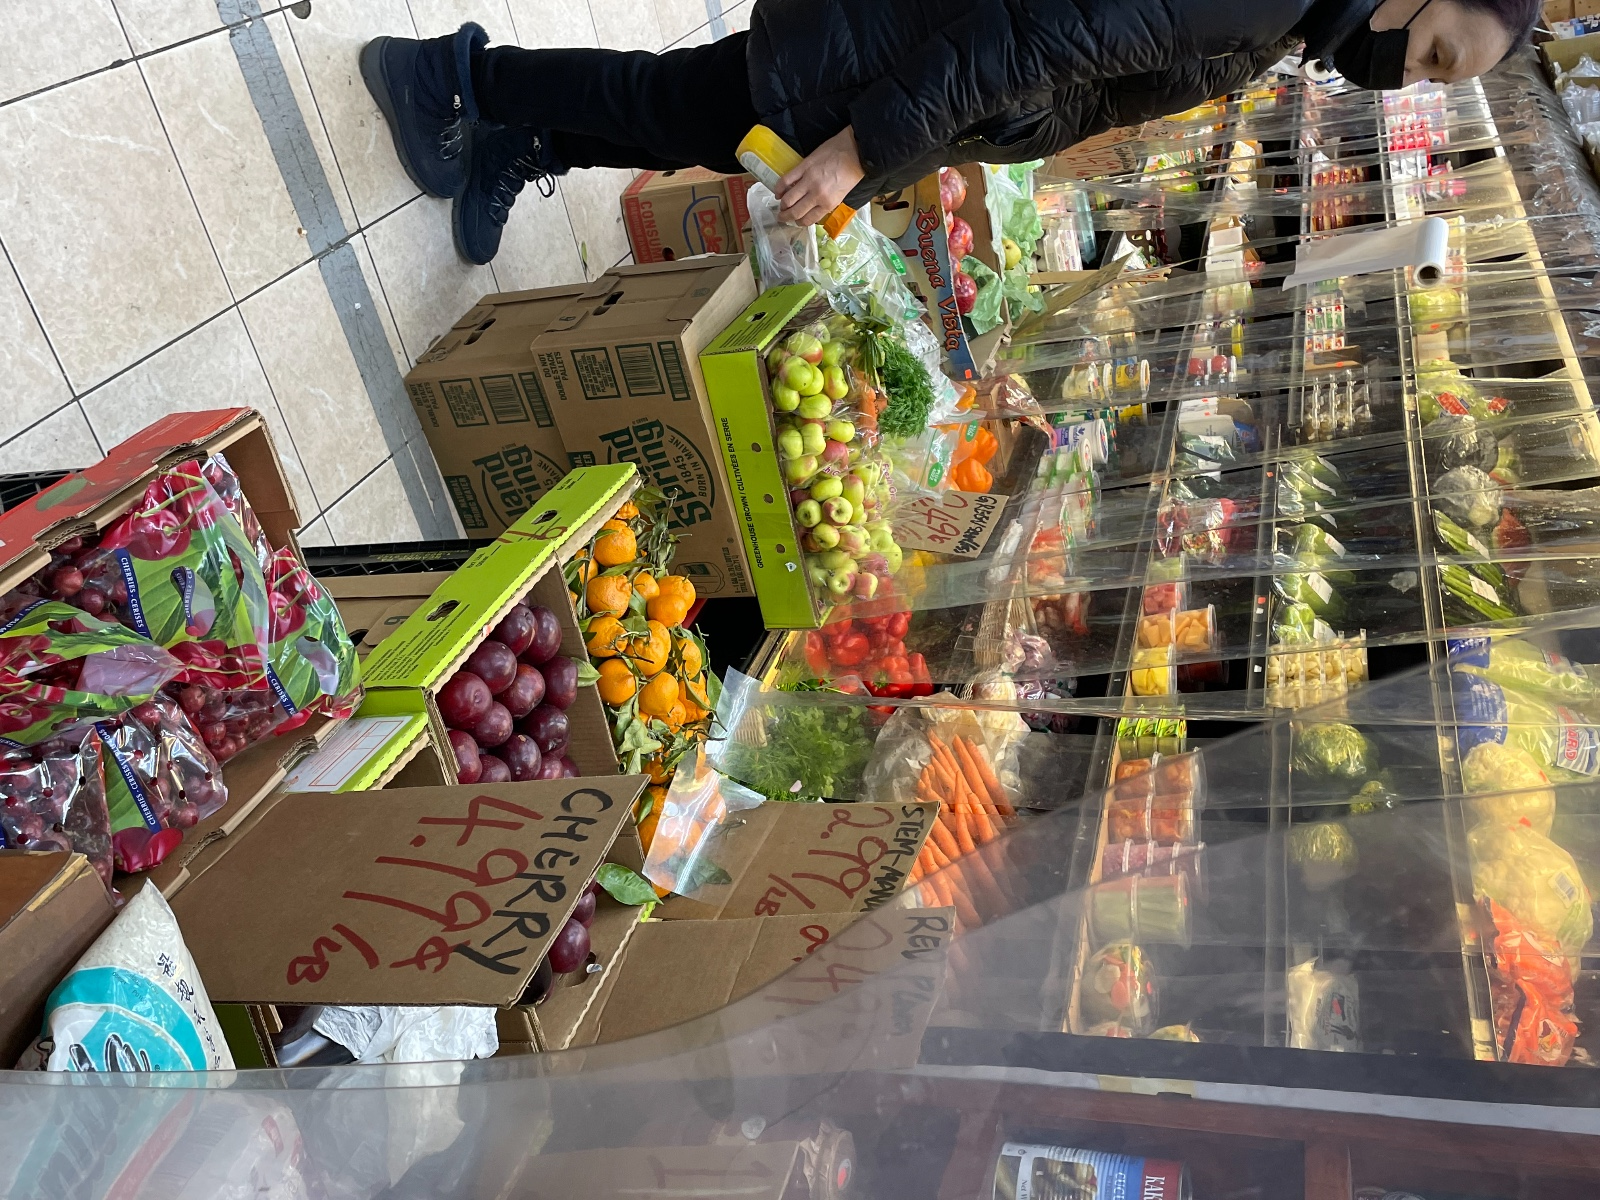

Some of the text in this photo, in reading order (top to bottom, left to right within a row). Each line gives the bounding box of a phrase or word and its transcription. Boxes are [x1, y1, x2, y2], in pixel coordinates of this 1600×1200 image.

[640, 201, 664, 262] CONSUM
[698, 208, 723, 254] Dole
[916, 205, 963, 351] Buena Vista
[538, 354, 552, 378] DO NOT
[546, 352, 567, 400] DOUBLE STACK
[553, 352, 568, 380] PALLETS
[409, 384, 423, 406] DO NOT
[416, 382, 440, 428] DOUBLE STACK
[424, 382, 439, 409] PALLETS
[720, 417, 732, 442] SERRE
[727, 442, 736, 453] EN
[472, 452, 529, 518] land
[631, 419, 712, 528] Spring
[668, 435, 706, 498] BORN IN MAINE
[673, 455, 694, 484] 1845
[740, 496, 753, 522] GROWN
[747, 523, 764, 568] GREENHOUSE
[121, 557, 136, 594] CHERRIES
[130, 598, 144, 628] CERISES
[271, 678, 289, 703] CERISES
[122, 765, 138, 790] CERISES
[136, 794, 156, 825] CHERRIES
[452, 788, 614, 975] CHERRY
